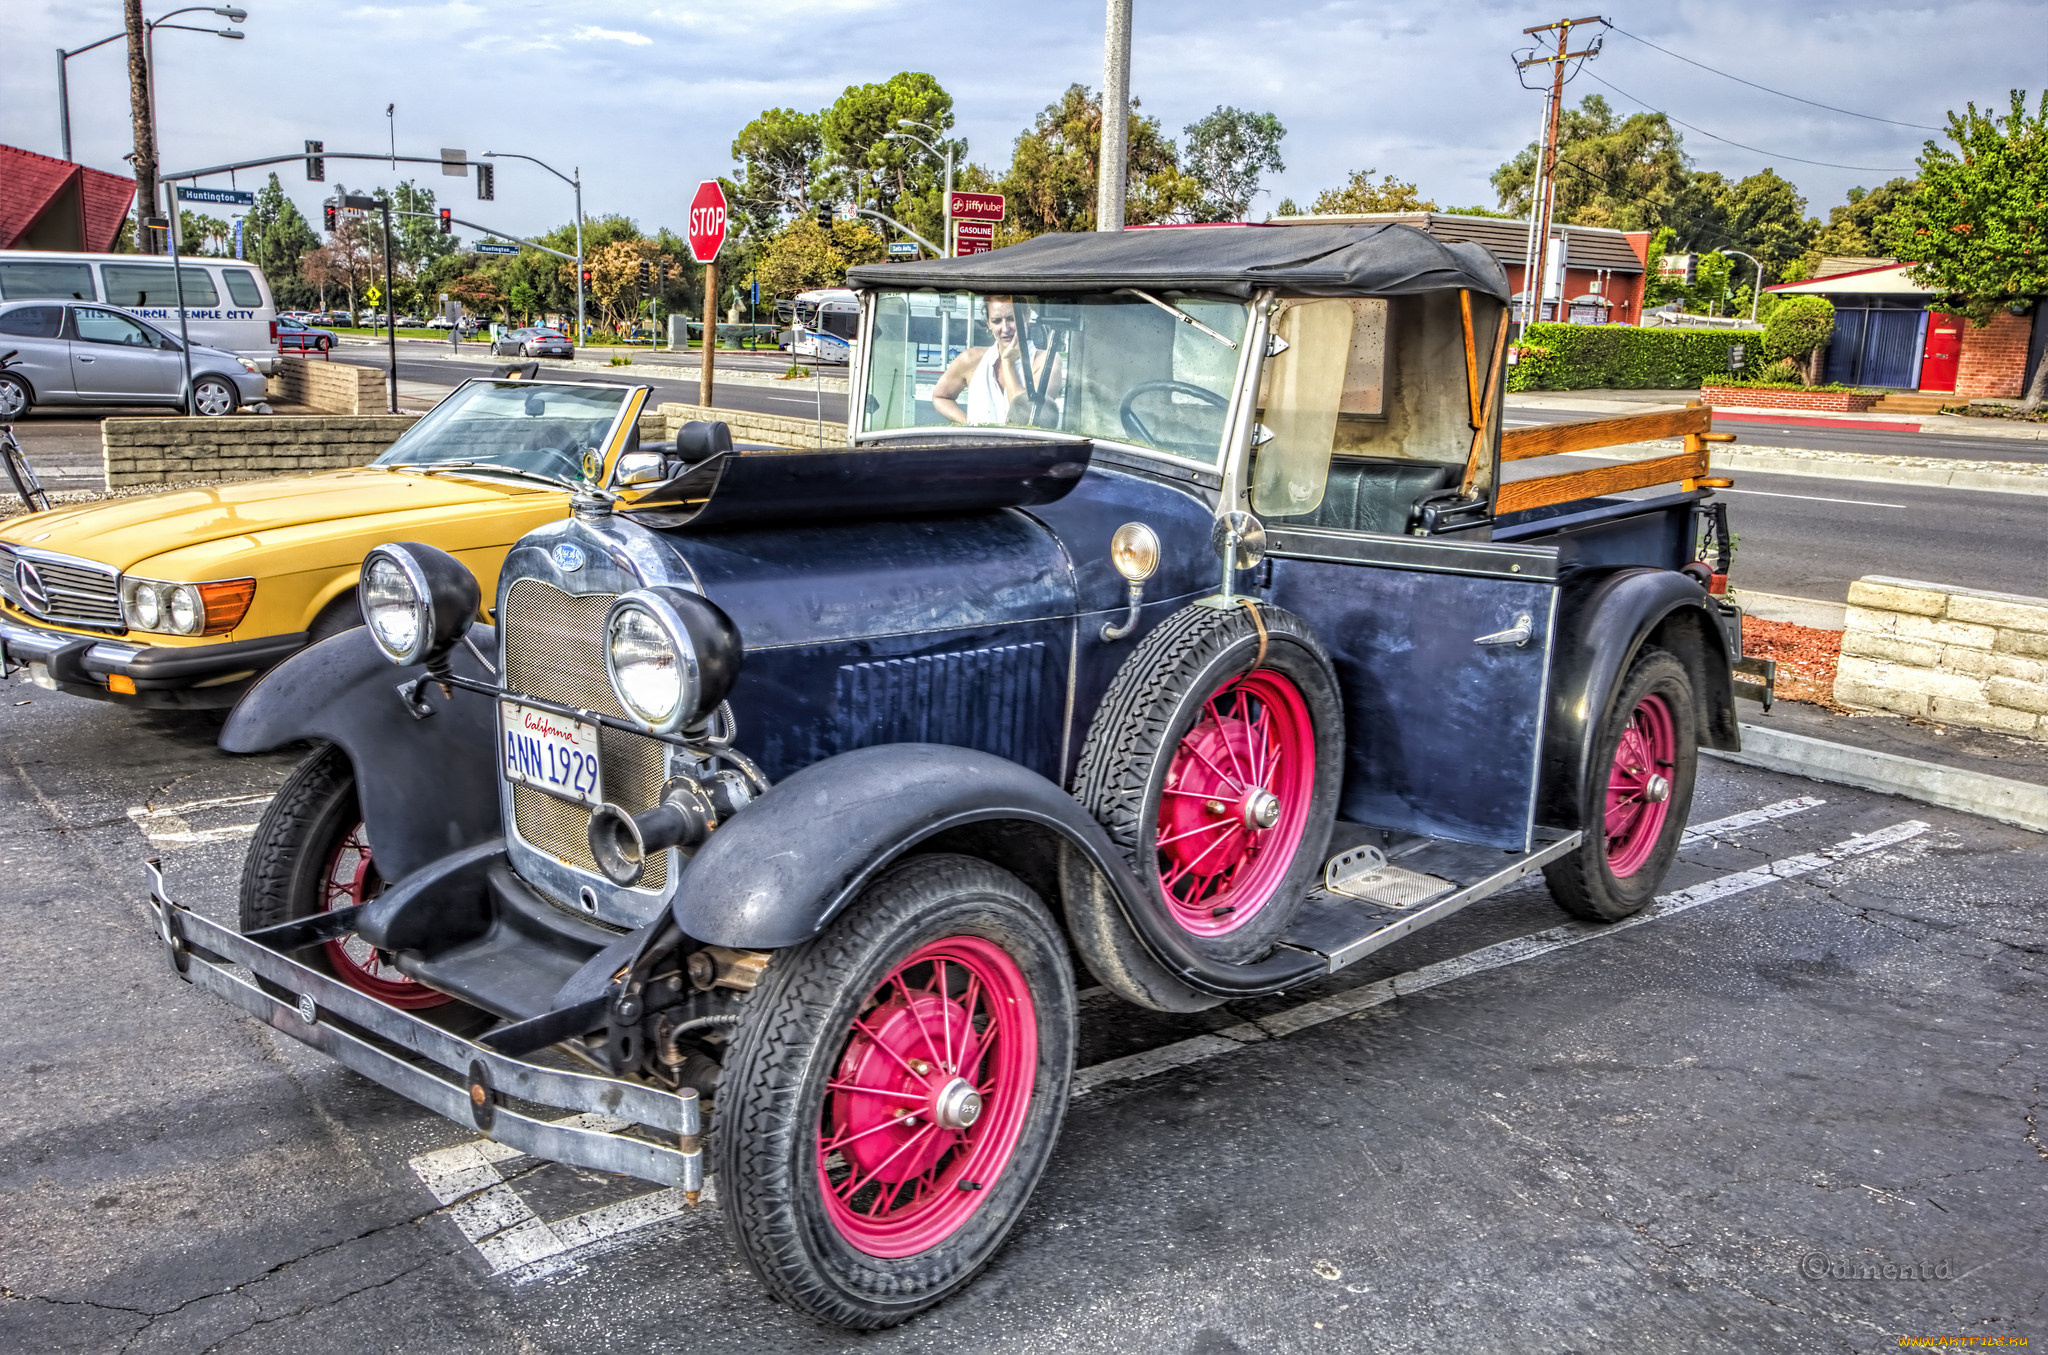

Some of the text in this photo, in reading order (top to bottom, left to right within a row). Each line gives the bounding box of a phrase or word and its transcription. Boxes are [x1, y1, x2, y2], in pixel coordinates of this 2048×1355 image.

[186, 190, 235, 203] Huntington
[691, 207, 724, 236] STOP
[959, 226, 991, 235] GASOLINE
[174, 309, 222, 319] TEMPLE
[226, 310, 254, 319] CITY
[525, 713, 579, 745] California
[508, 730, 597, 794] ANN 1929
